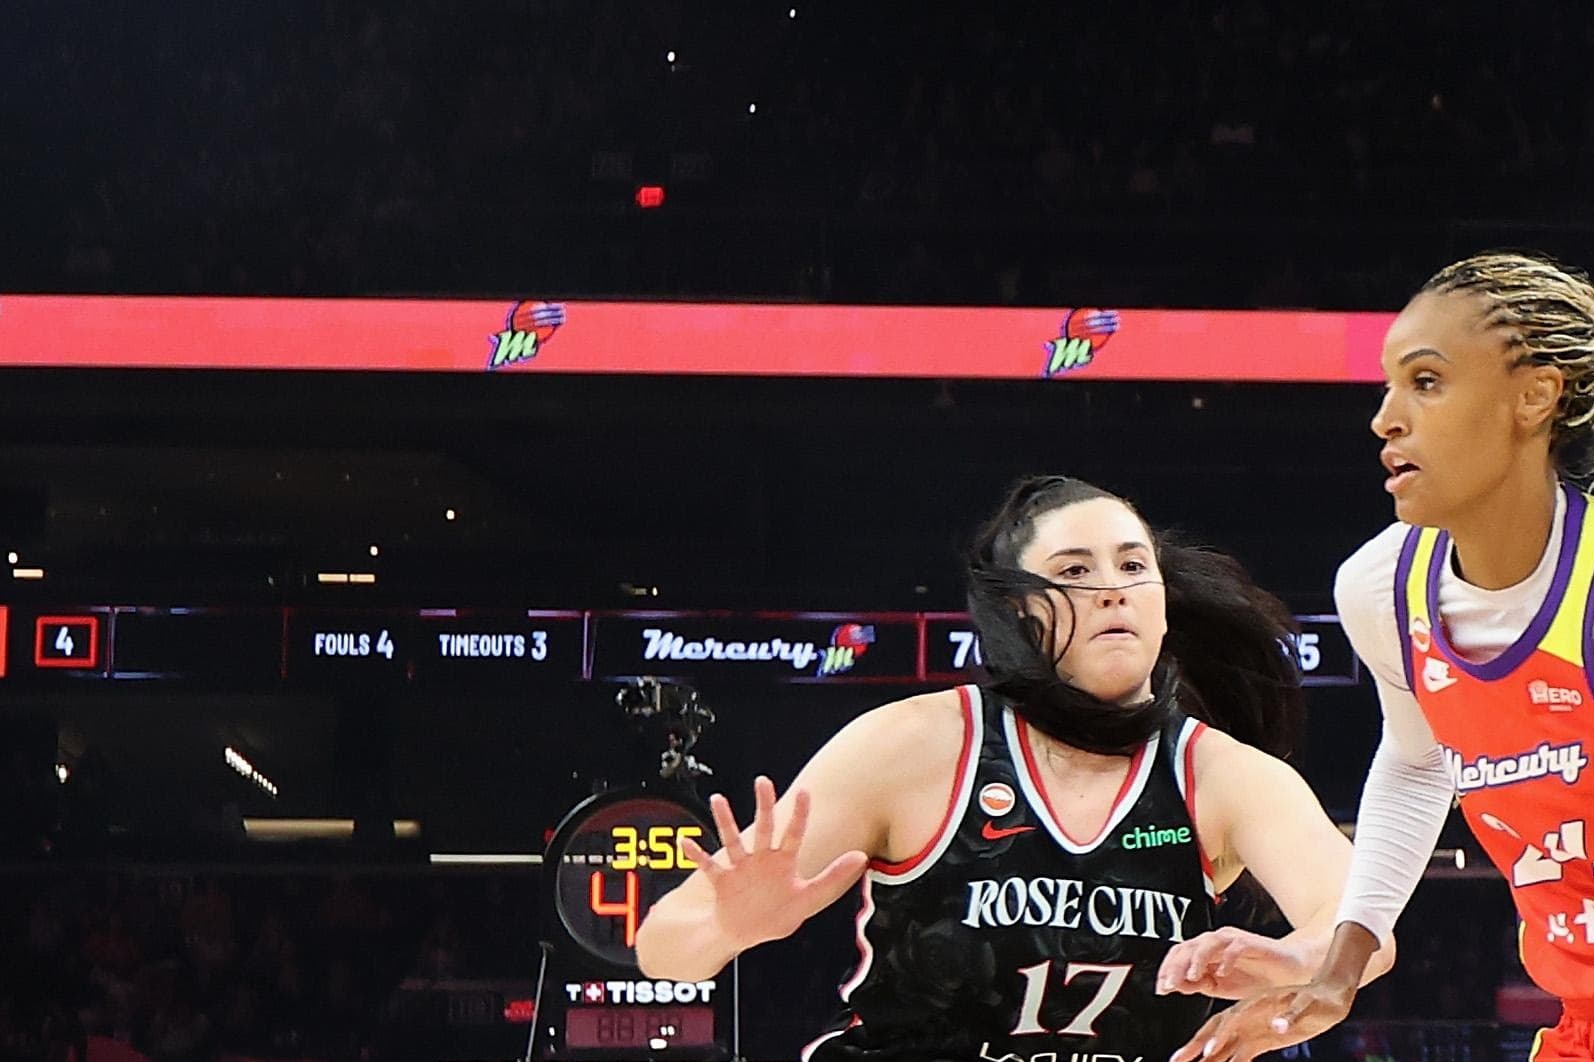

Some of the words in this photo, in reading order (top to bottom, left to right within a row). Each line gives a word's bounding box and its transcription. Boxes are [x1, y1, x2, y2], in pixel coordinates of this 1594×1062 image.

[55, 627, 73, 655] 4
[315, 633, 370, 656] FOULS
[376, 629, 394, 660] 4
[439, 634, 525, 657] TIMEOUTS
[531, 631, 547, 661] 3
[643, 629, 817, 669] Mercury
[1122, 825, 1192, 850] chime
[961, 877, 1084, 929] ROSE
[1088, 886, 1192, 943] CITY
[606, 981, 716, 1004] TISSOT
[1009, 959, 1134, 1037] 17
